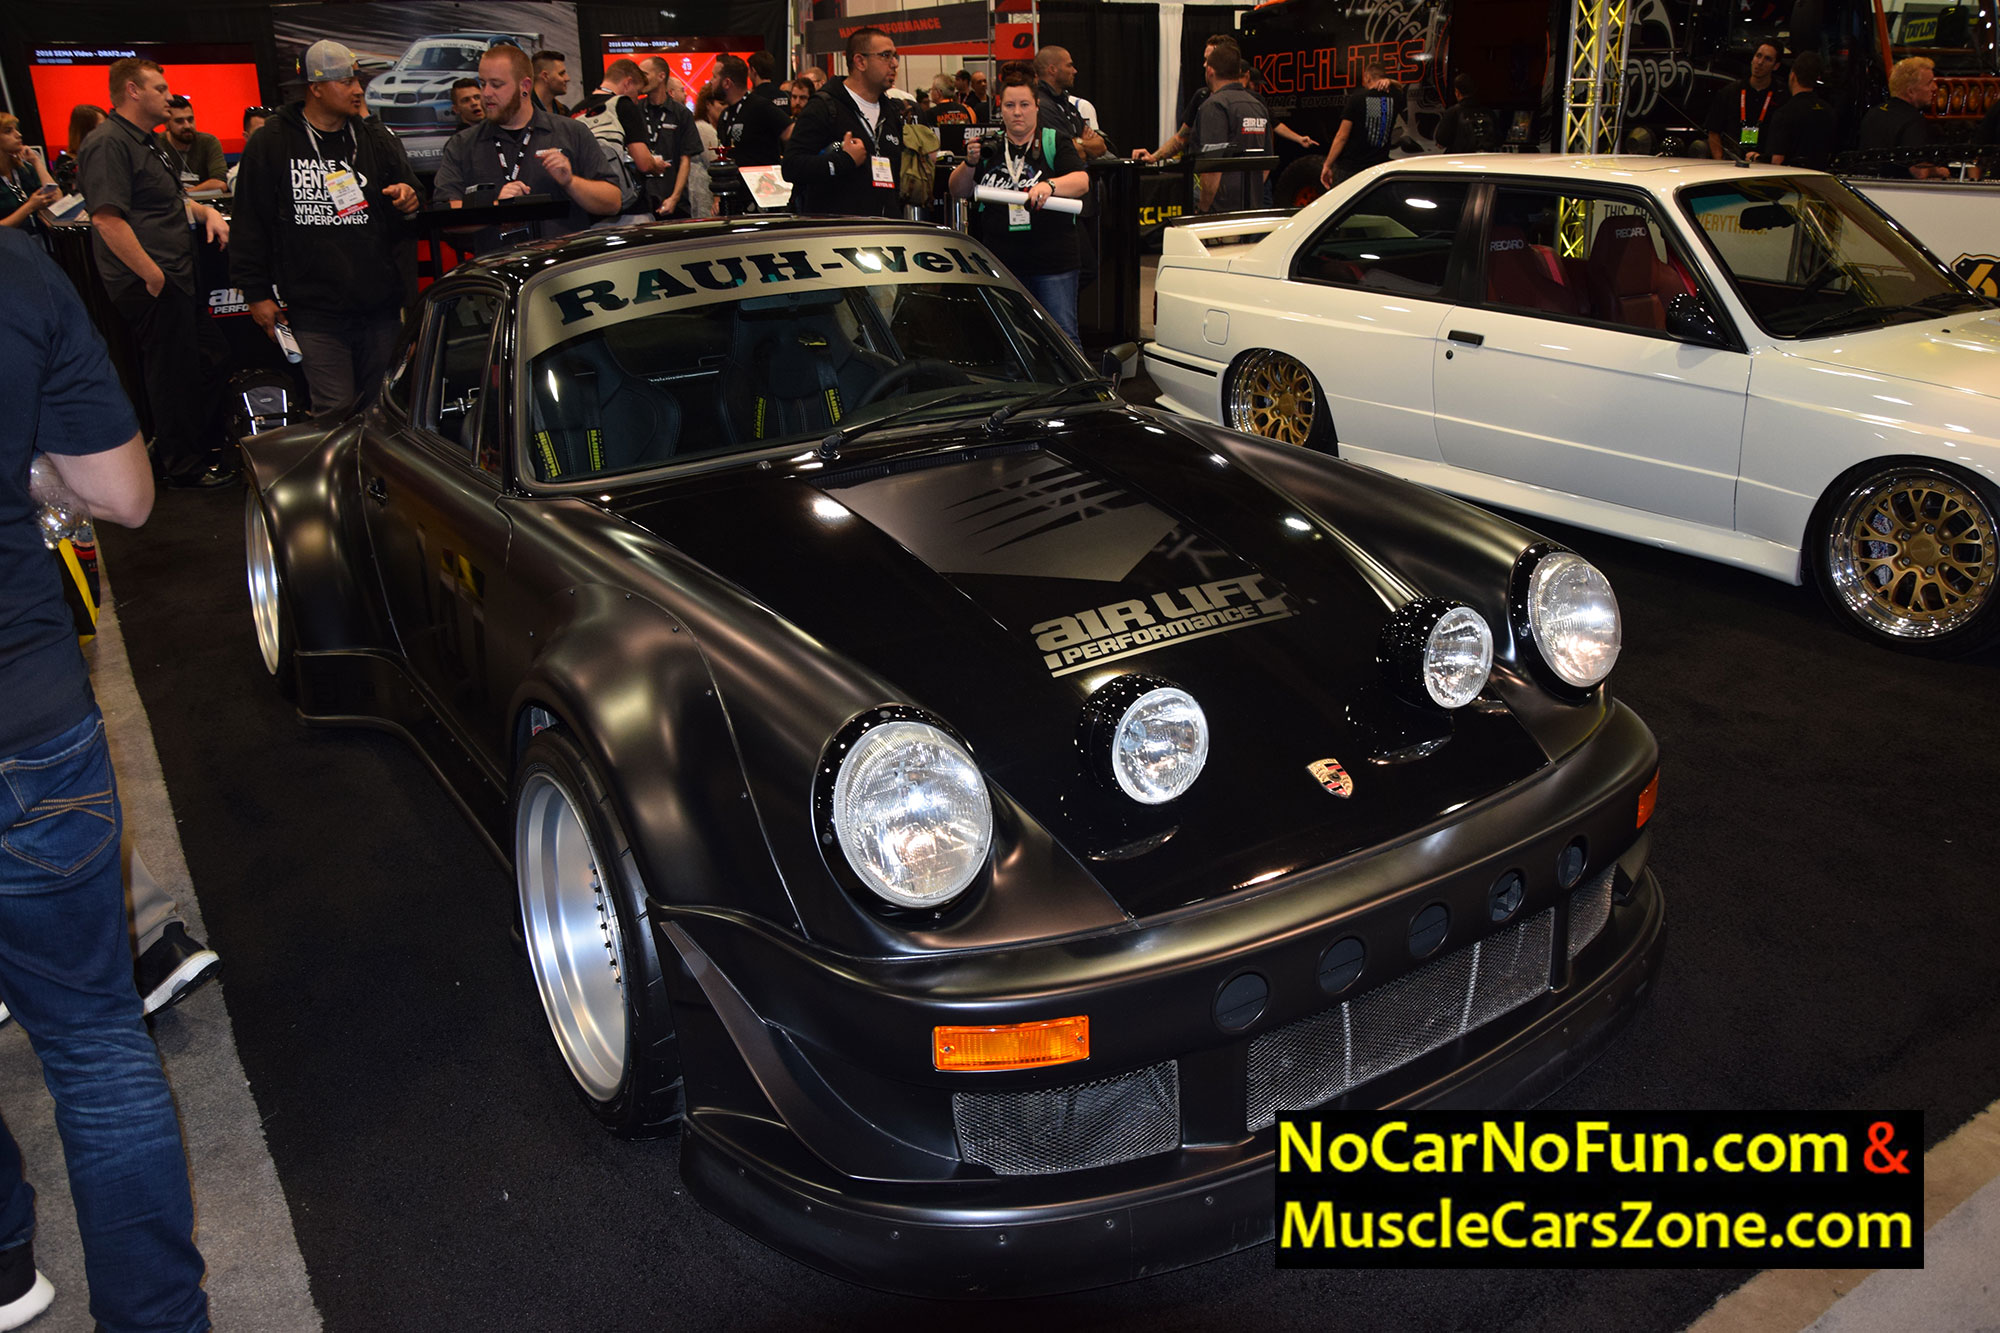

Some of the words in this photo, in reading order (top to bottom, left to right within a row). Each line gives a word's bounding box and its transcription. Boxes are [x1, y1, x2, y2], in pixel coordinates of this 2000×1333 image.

[291, 159, 295, 170] I
[297, 159, 336, 171] MAKE
[294, 204, 334, 215] WHAT'S
[294, 214, 369, 226] SUPERPOWER?
[1616, 227, 1647, 239] RECARO
[1490, 239, 1524, 251] RECARO
[550, 245, 996, 326] RAUH-Welt
